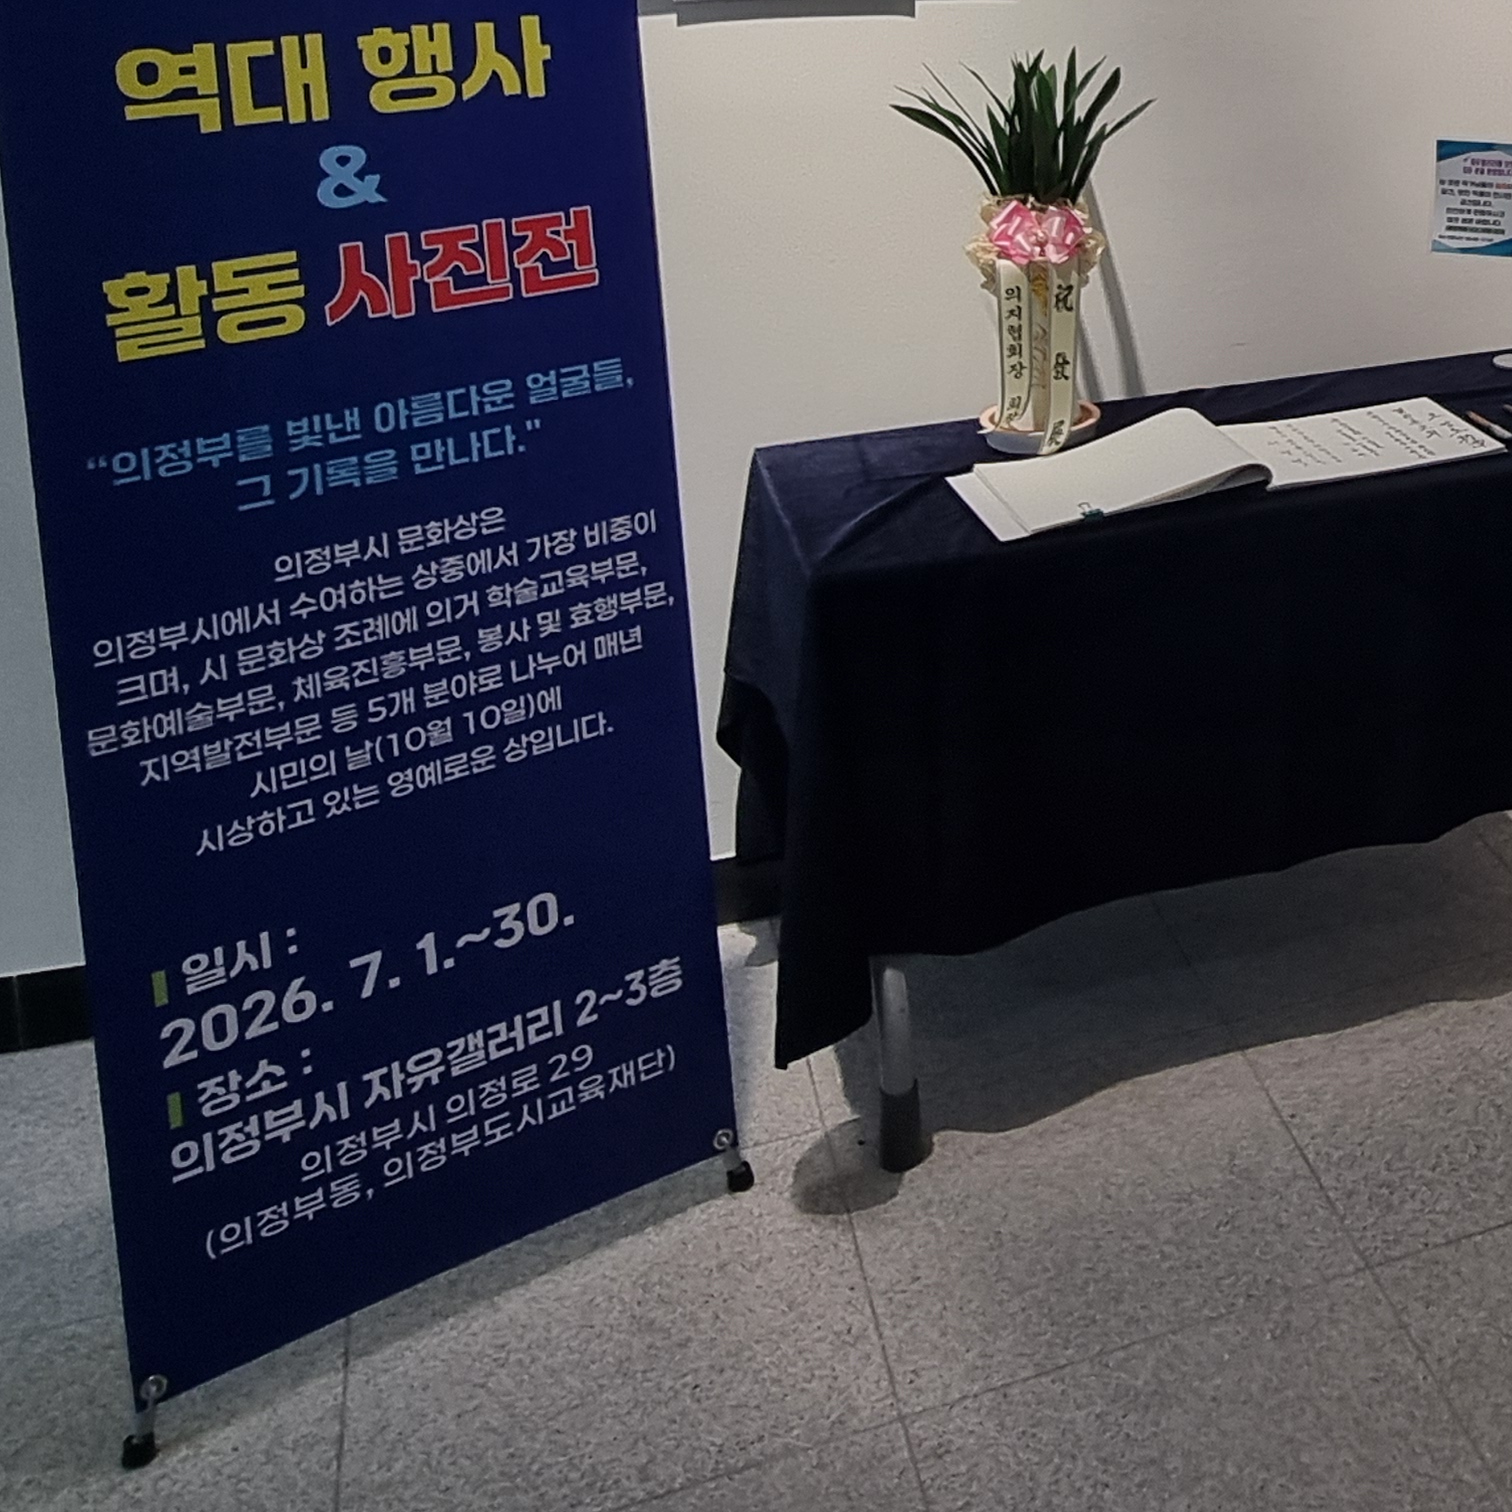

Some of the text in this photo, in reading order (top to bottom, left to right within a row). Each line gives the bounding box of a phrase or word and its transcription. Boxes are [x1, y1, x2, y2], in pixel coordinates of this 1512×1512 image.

[114, 14, 553, 135] 역대 행사
[316, 144, 389, 209] &
[101, 205, 600, 363] 활동 사진전
[86, 357, 635, 487] “의정부를 빛낸 아름다운 얼굴들,
[235, 476, 276, 513] 그
[289, 448, 399, 505] 기록을
[92, 508, 657, 668] 의정부시에서 수여하는 상중에서 가장 비중이
[273, 506, 507, 583] 의정부시 문화상은
[87, 581, 675, 757] 문화예술부문, 체육진흥부문, 봉사 및 효행부문,
[116, 551, 648, 706] 크며, 시 문화상 조례에 의거 학술교육부문,
[139, 625, 644, 786] 지역발전부문 등 5개 분야로 나누어 매년
[250, 685, 563, 798] 시민의 날(10월 10일)에
[196, 711, 615, 857] 시상하고 있는 영예로운 상입니다.
[160, 891, 577, 1070] 2026. 7. 1.~30.
[180, 930, 272, 996] 일시
[170, 955, 685, 1185] 의정부시 자유갤러리 2~3층
[197, 1055, 289, 1118] 장소
[299, 1044, 595, 1182] 의정부시 의정로 29
[204, 1044, 677, 1260] (의정부동, 의정부도시교육재단)
